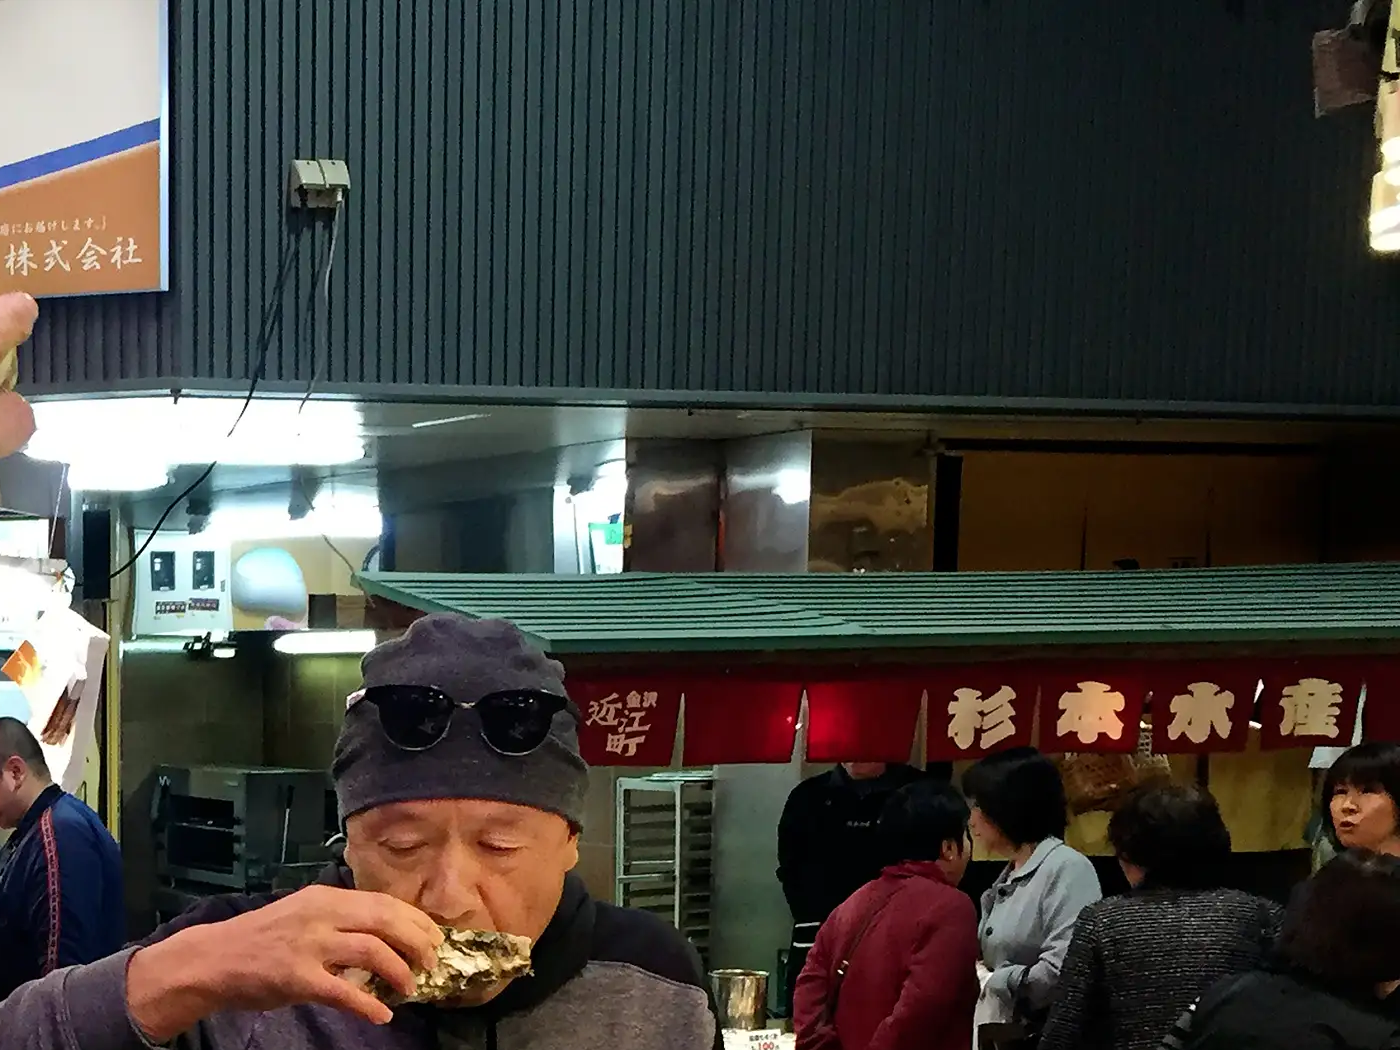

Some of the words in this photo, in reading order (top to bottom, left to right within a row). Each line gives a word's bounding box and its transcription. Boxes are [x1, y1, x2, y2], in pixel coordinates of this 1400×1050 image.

[585, 691, 652, 757] 近江町
[947, 677, 1344, 750] 杉本水産
